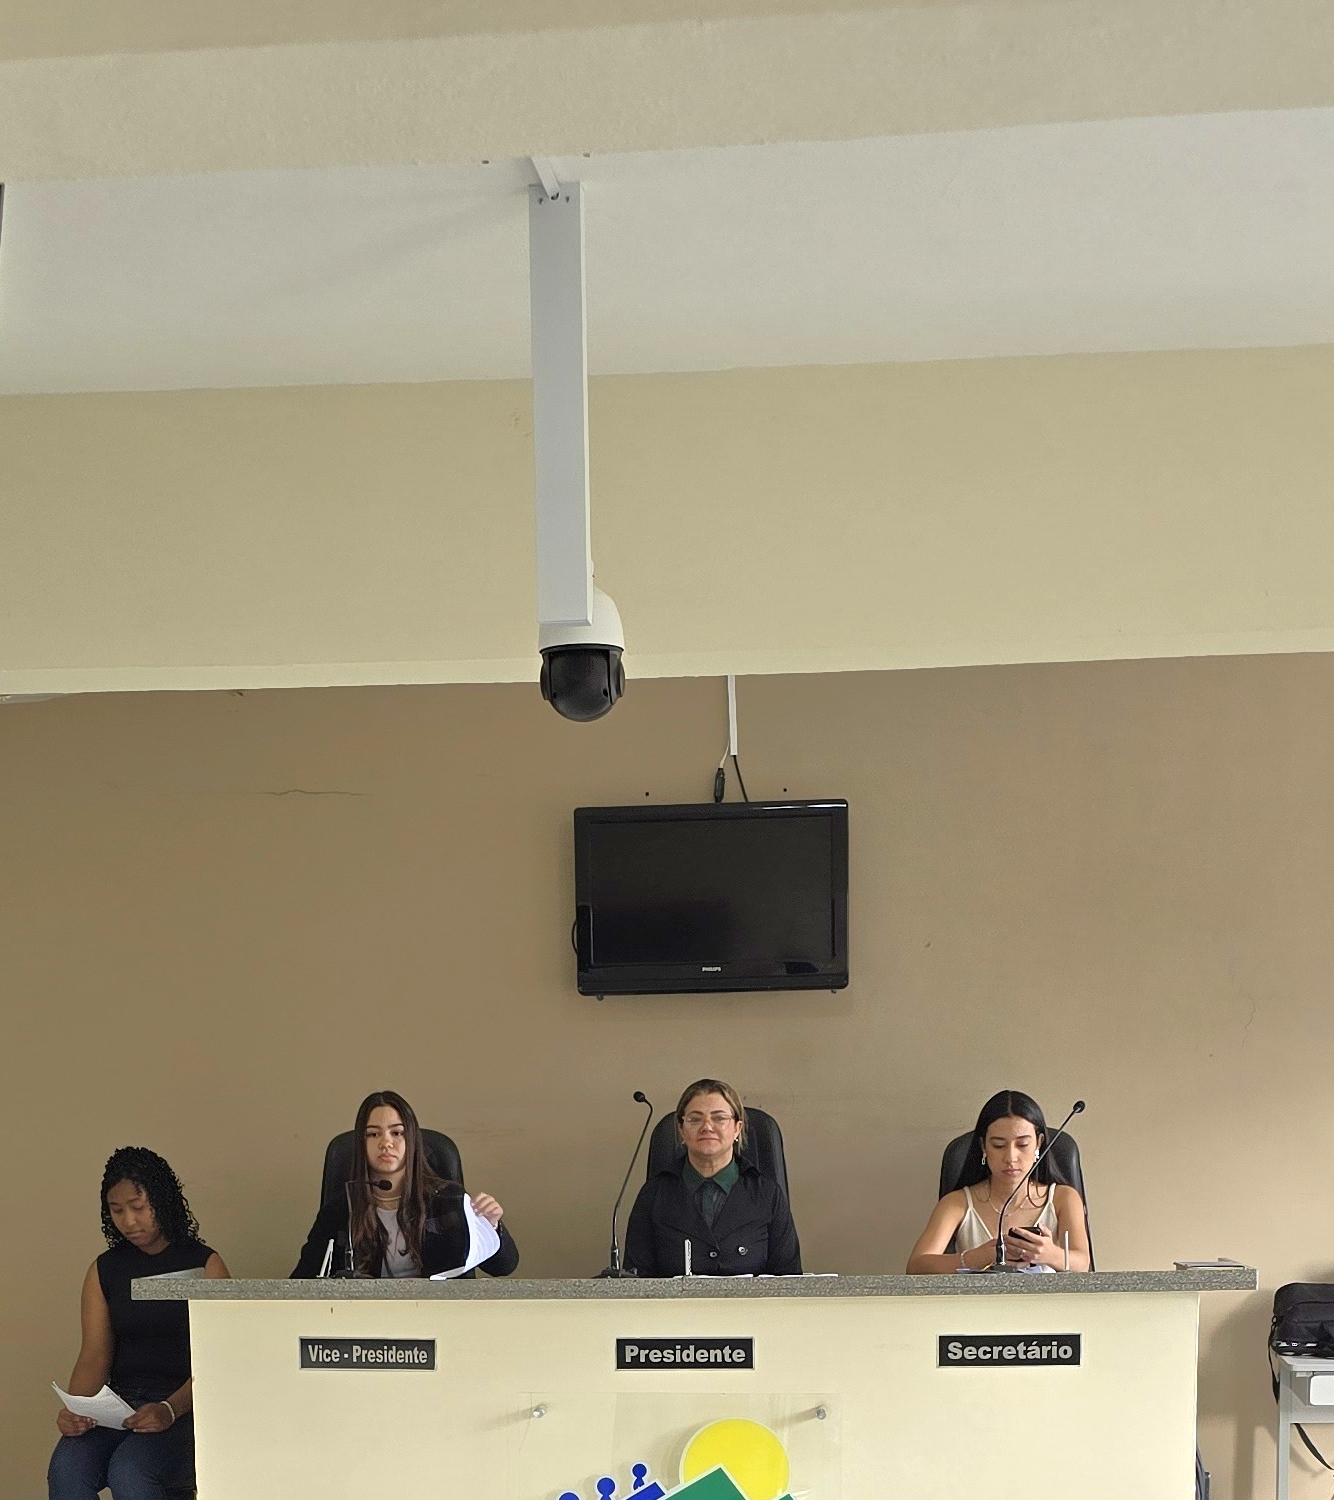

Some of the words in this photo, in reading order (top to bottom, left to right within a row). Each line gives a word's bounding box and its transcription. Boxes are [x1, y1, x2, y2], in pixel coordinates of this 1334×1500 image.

[308, 1344, 340, 1362] Vice
[352, 1345, 428, 1364] Presidente
[624, 1344, 746, 1363] Presidente
[947, 1340, 1073, 1360] Secretário
